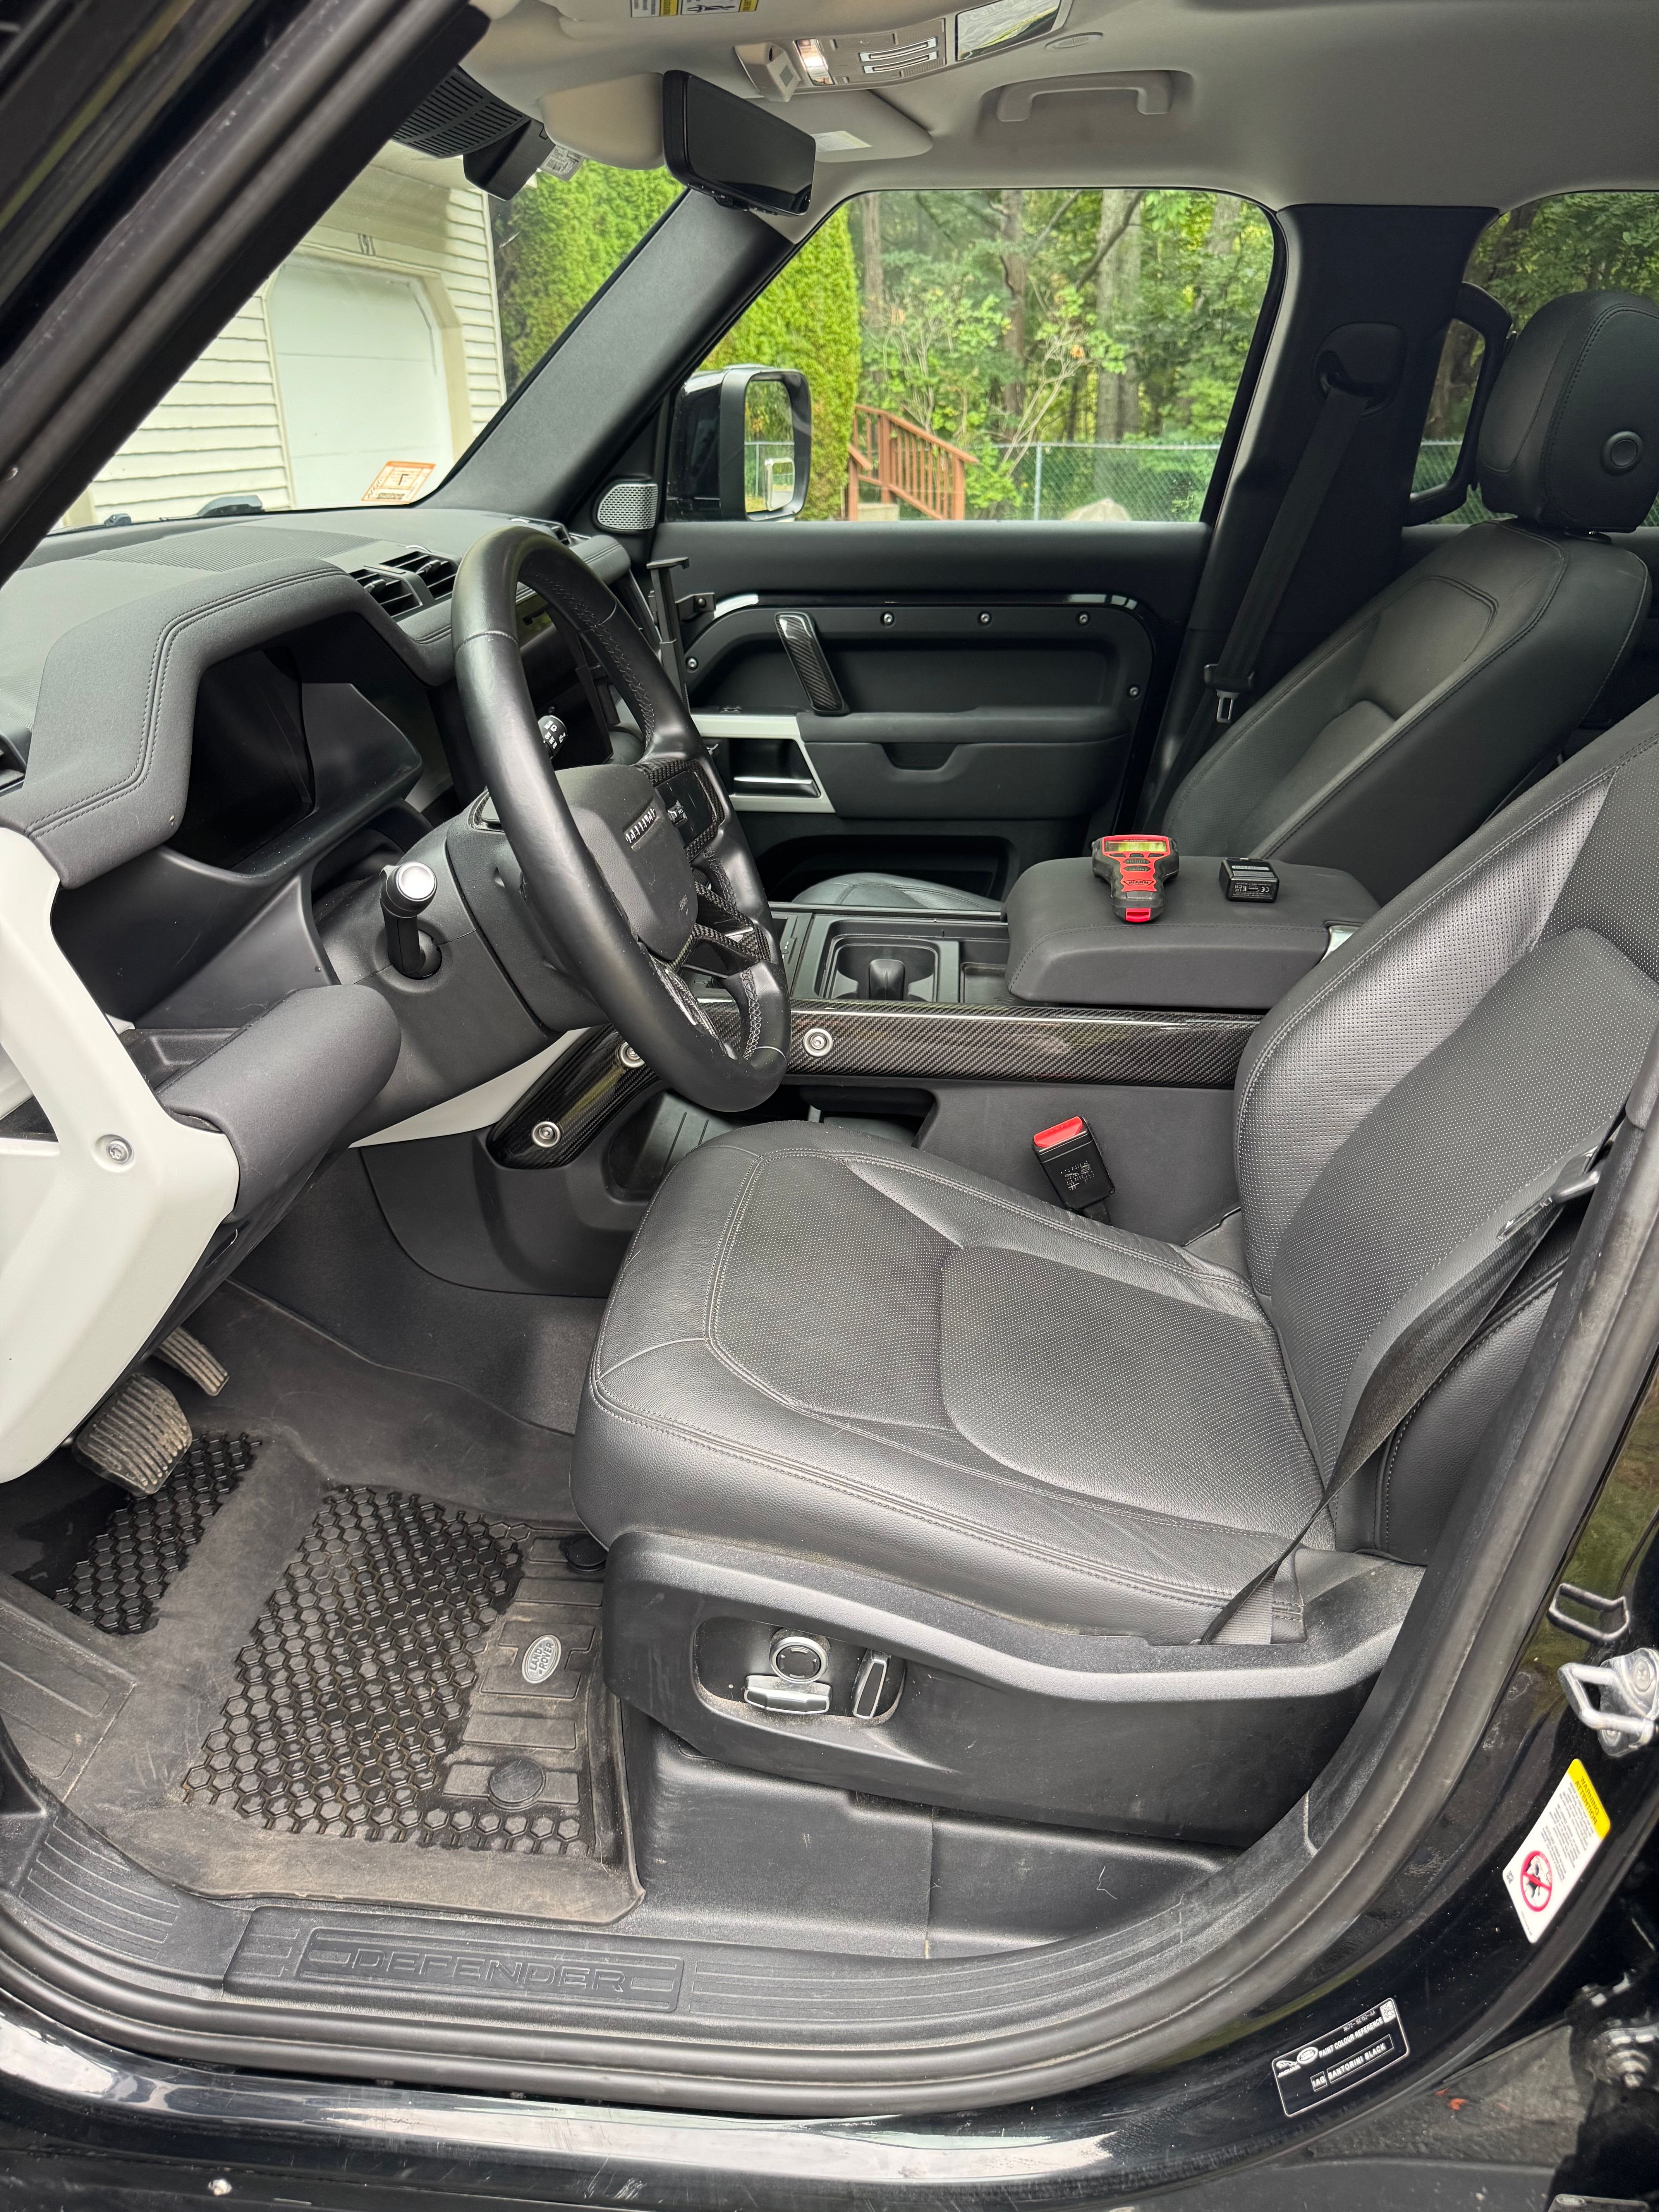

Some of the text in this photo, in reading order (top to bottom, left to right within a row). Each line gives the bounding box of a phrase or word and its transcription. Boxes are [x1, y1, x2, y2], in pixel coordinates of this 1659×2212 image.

[529, 1648, 542, 1671] LAND
[538, 1642, 554, 1670] ROVER
[1575, 1780, 1597, 1825] ATTENTION
[1580, 1776, 1599, 1816] WARNING
[352, 1948, 625, 1992] DEFENDER
[1318, 2016, 1383, 2058] PAINT COLOUR REFERENCE
[1328, 2043, 1387, 2080] SANTORINI BLACK
